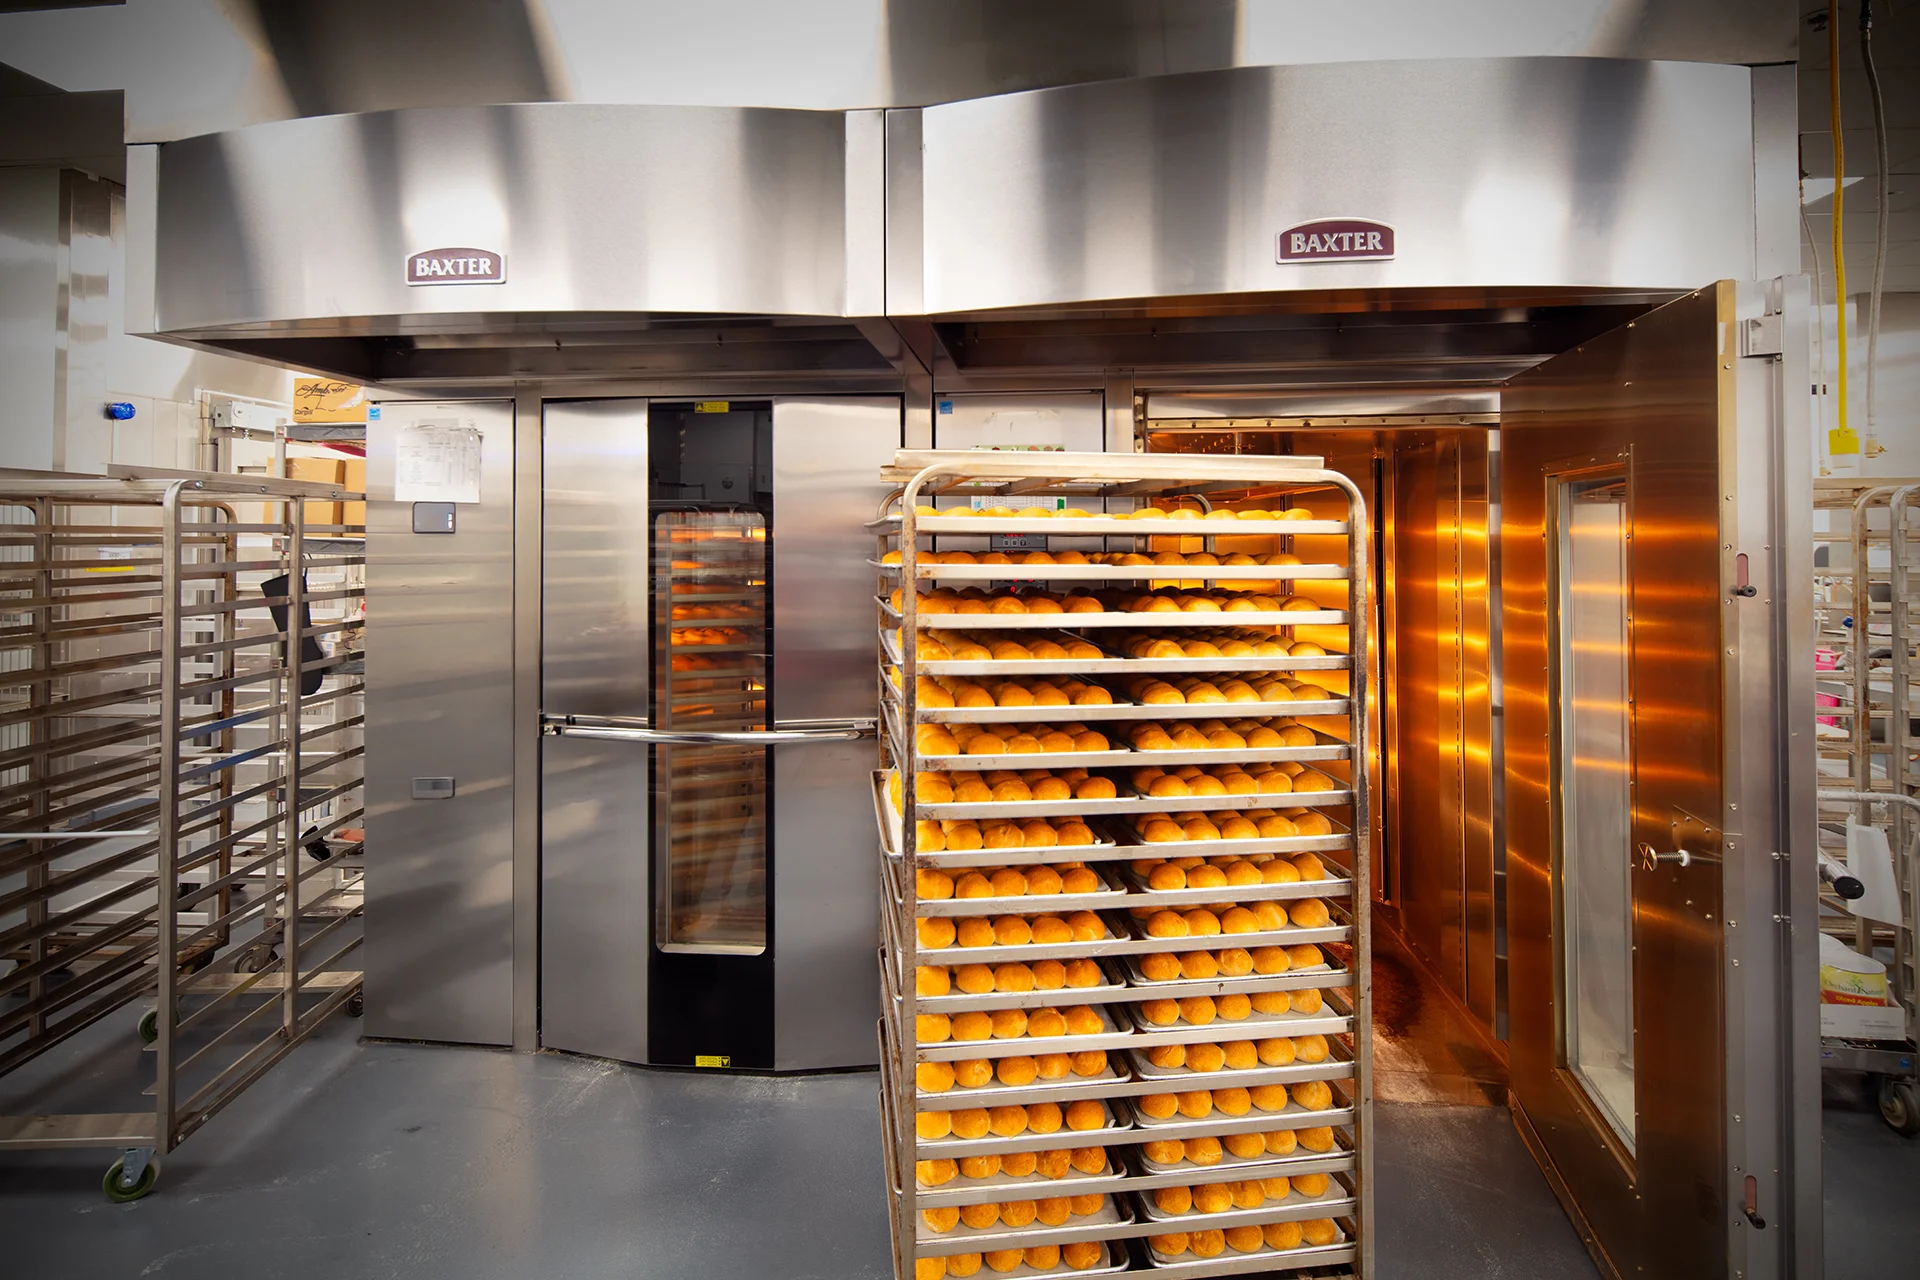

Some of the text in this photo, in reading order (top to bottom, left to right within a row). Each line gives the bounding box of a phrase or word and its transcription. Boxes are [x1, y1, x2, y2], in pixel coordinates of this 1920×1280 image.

[1290, 231, 1384, 254] BAXTER
[415, 258, 492, 277] BAXTER
[294, 407, 313, 416] Cargill
[1824, 979, 1857, 994] Orchard
[1835, 994, 1856, 1004] Diced
